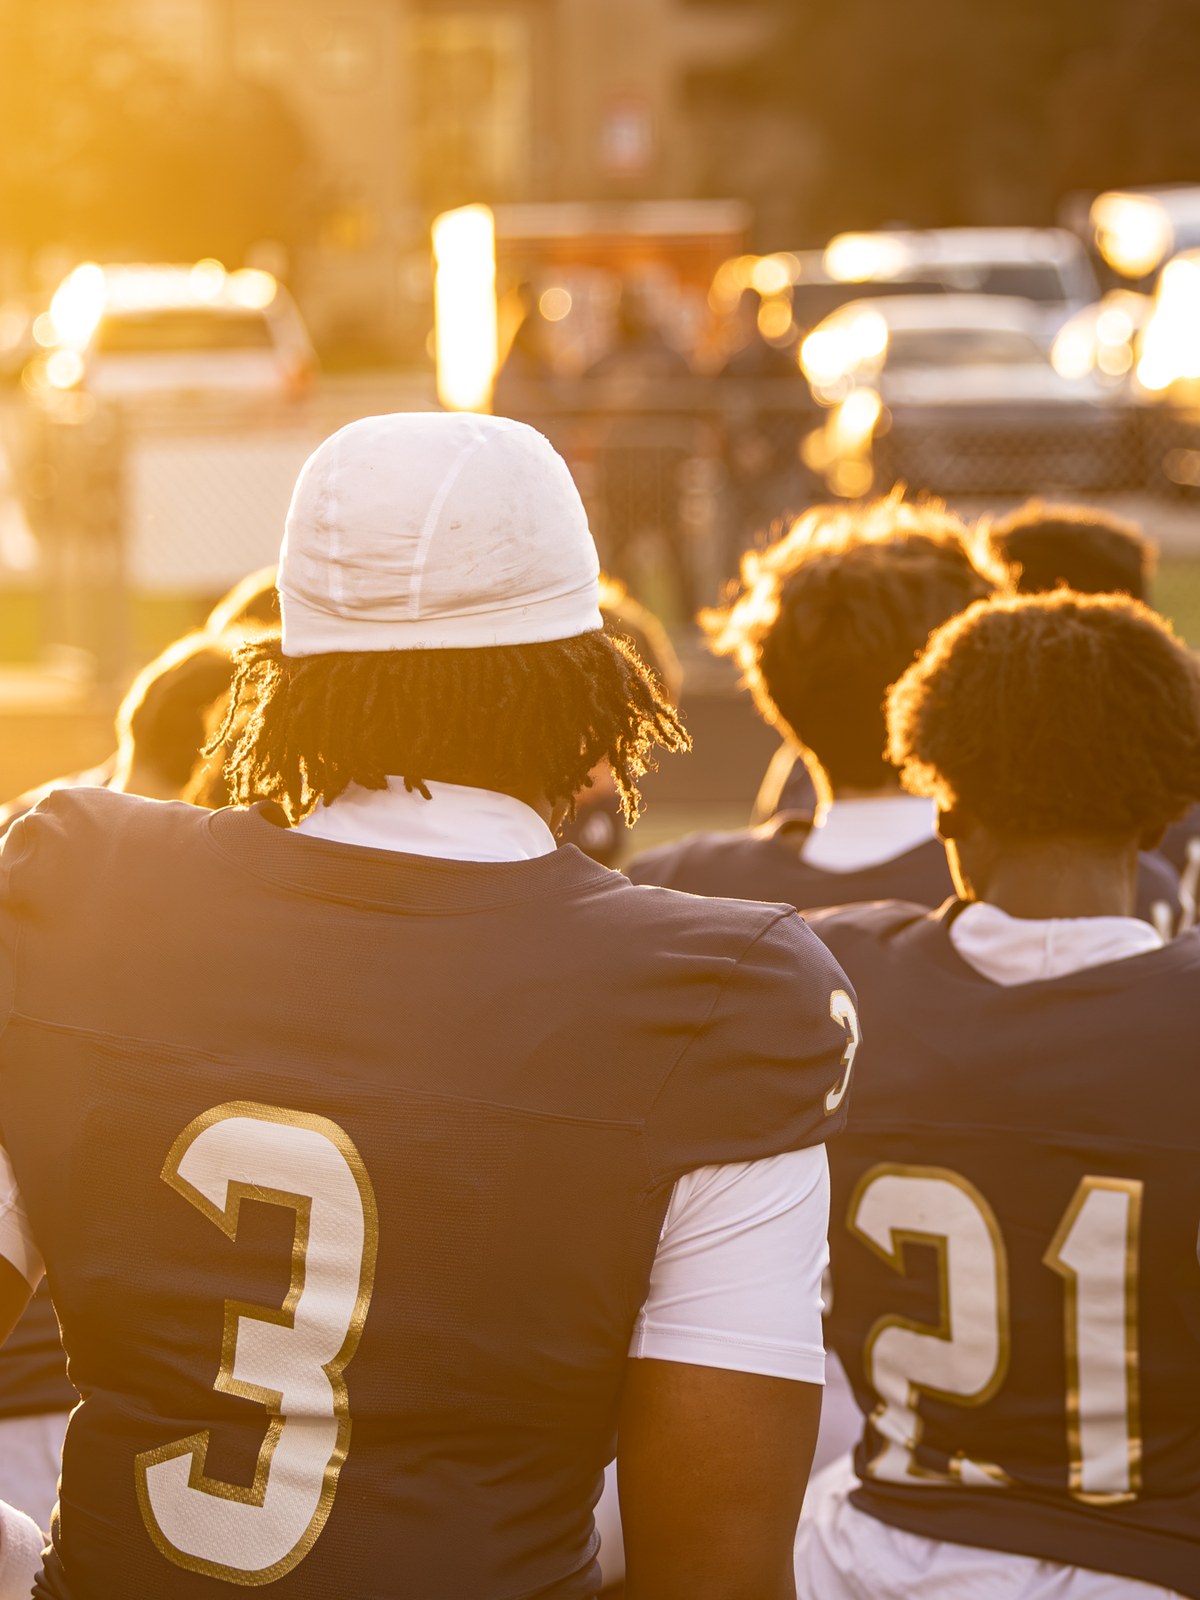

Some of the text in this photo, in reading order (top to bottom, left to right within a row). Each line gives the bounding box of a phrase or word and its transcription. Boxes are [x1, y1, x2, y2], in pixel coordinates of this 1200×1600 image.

[824, 989, 859, 1116] 3
[136, 1100, 379, 1587] 3
[846, 1161, 1144, 1505] 21
